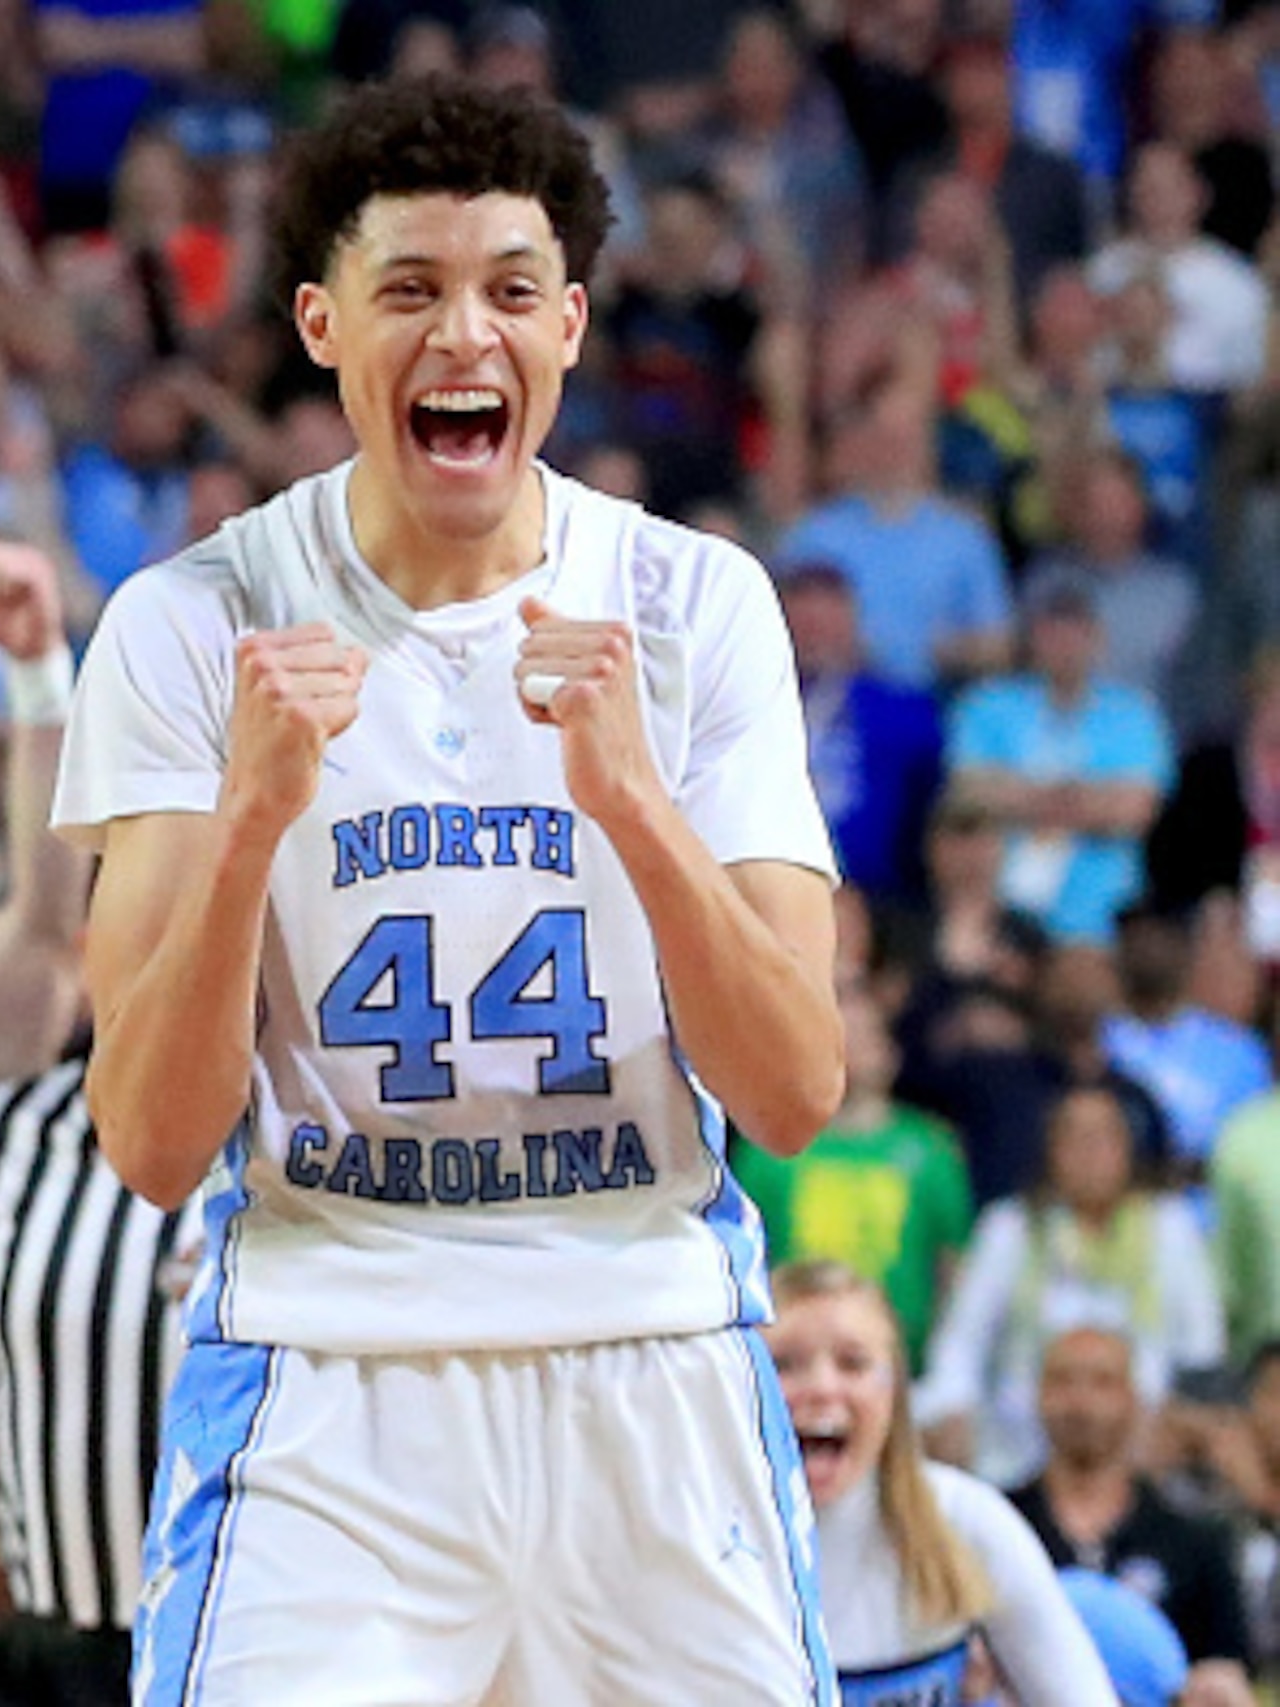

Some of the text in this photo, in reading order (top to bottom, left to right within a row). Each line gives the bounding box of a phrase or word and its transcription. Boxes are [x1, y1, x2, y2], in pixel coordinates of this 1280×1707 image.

[333, 804, 574, 888] NORTH
[317, 908, 612, 1102] 44
[285, 1121, 656, 1206] CAROLINA
